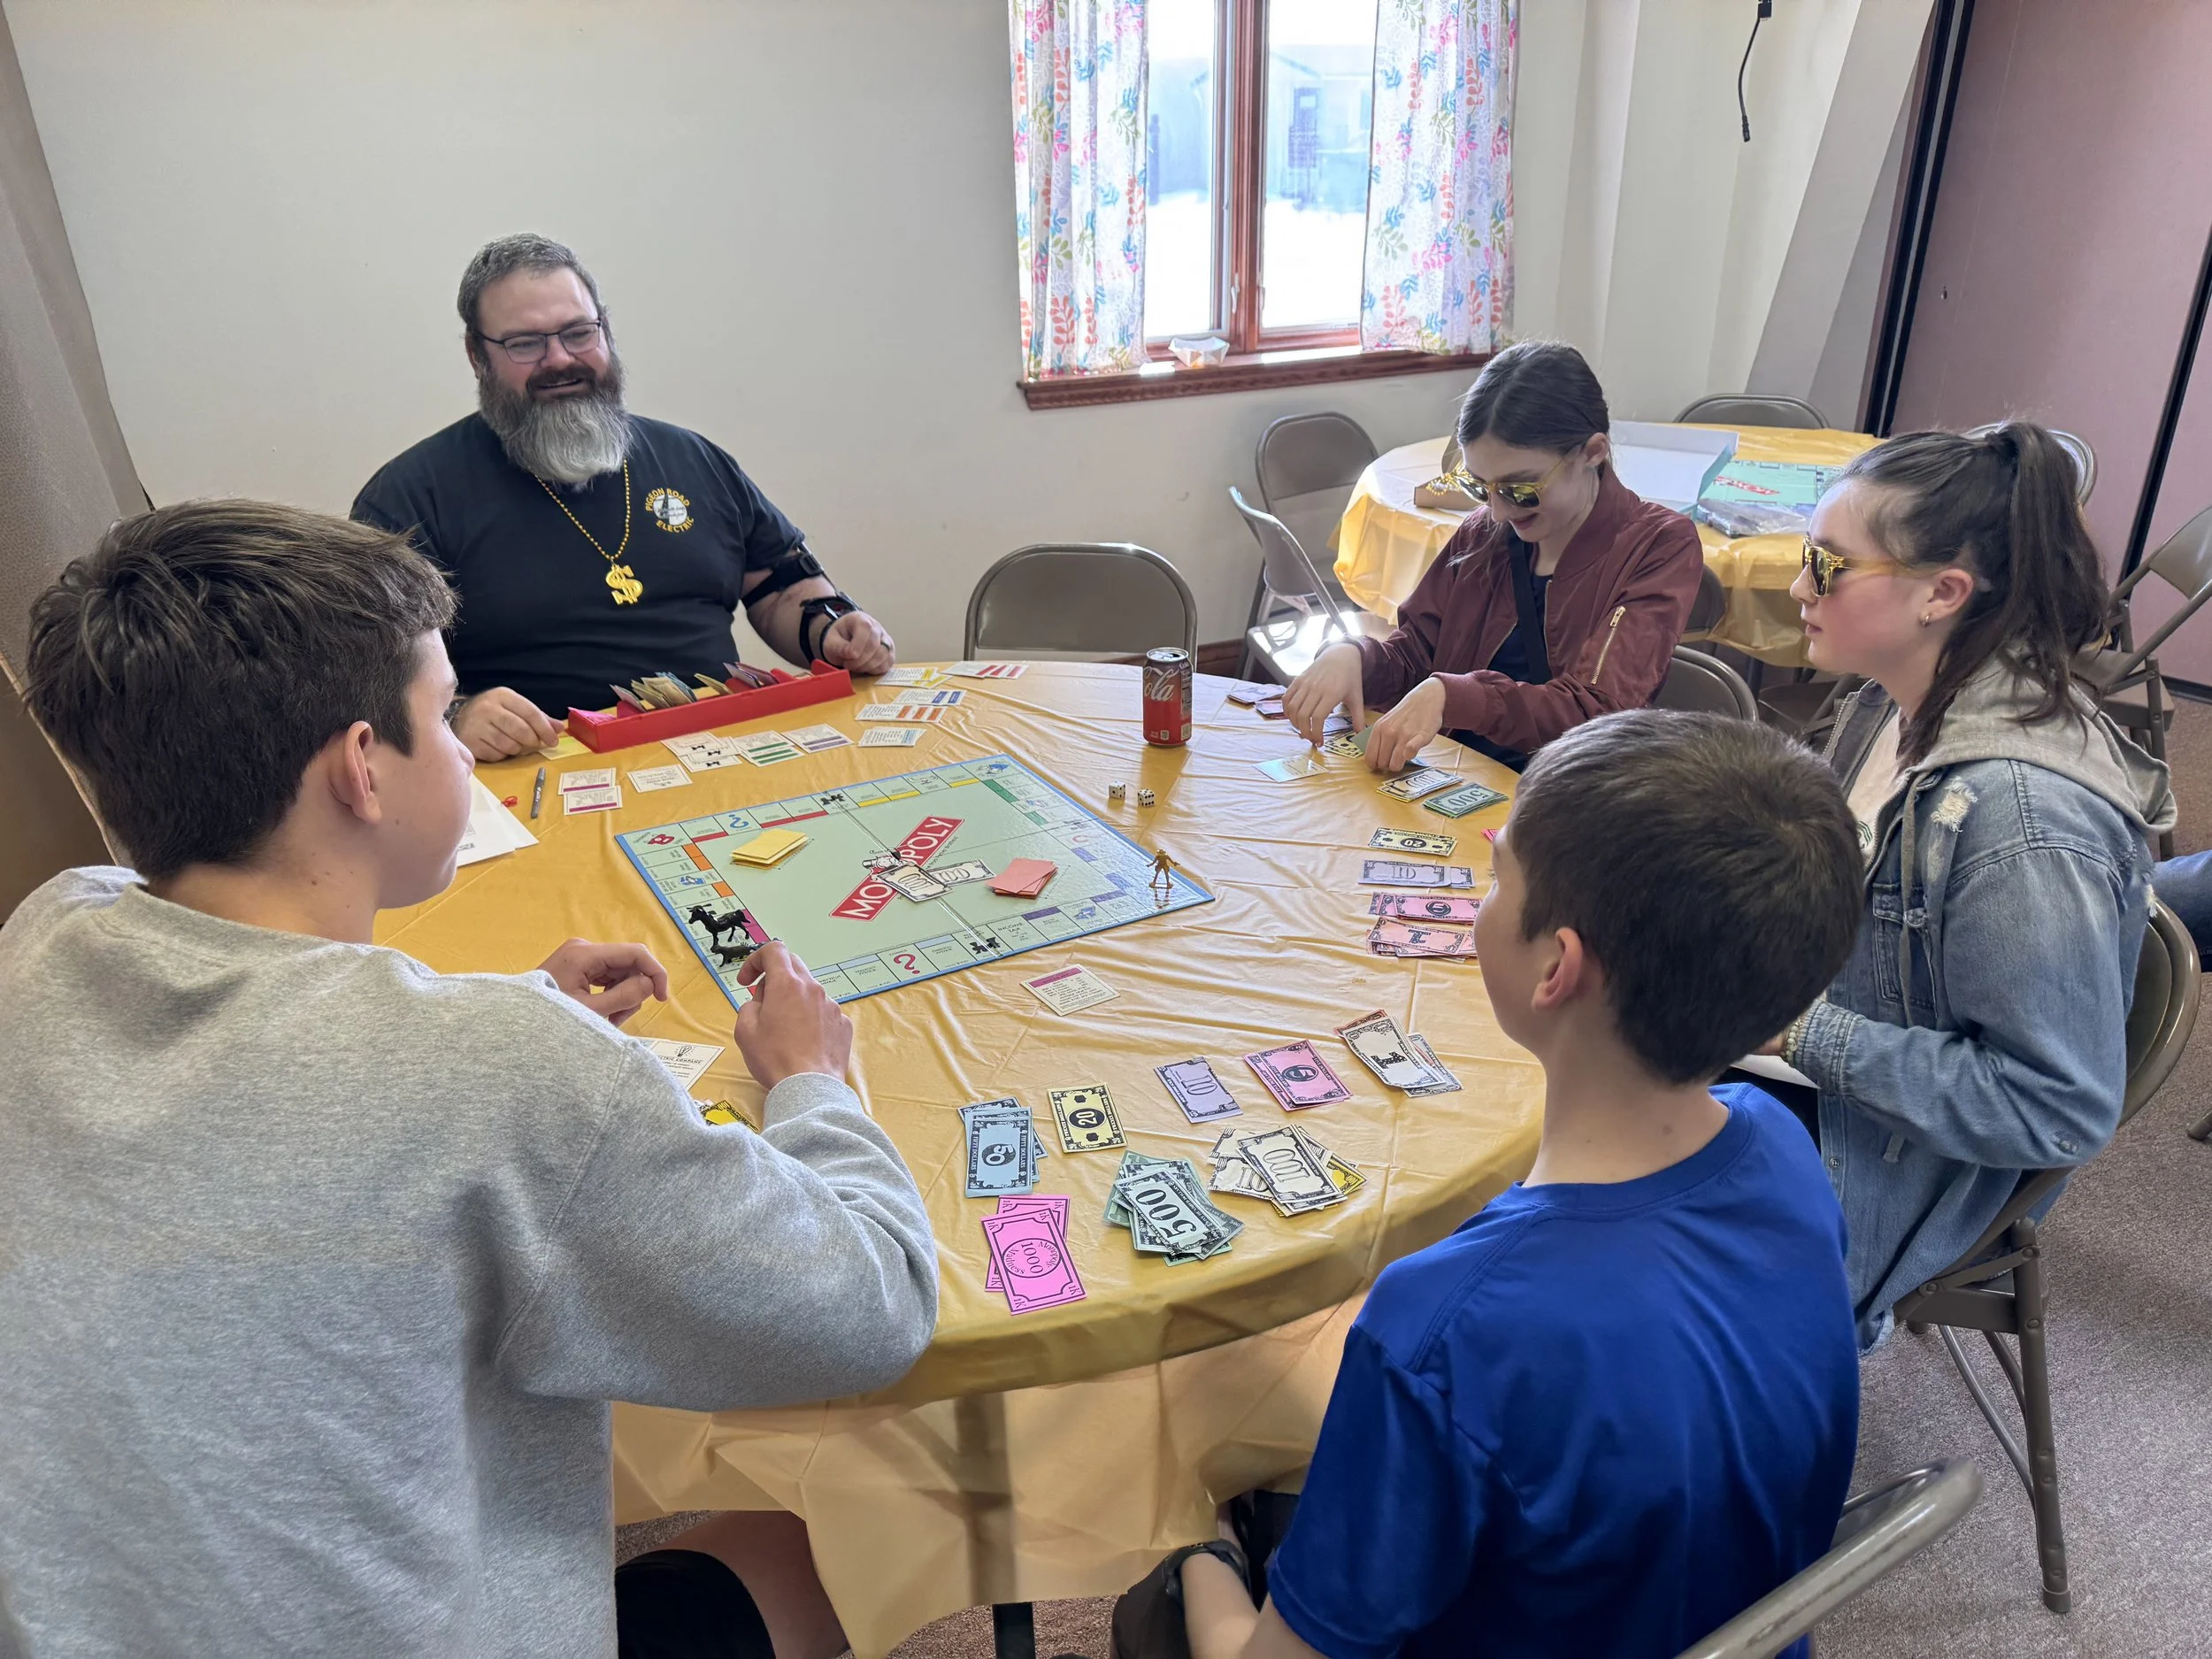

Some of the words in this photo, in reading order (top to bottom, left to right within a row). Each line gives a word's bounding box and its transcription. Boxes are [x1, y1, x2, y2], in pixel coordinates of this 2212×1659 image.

[645, 488, 664, 511] PIGEON
[667, 488, 690, 506] ROAD
[656, 516, 694, 533] ELECTRIC
[1448, 789, 1486, 807] 500
[840, 818, 954, 918] MOPOLY
[1392, 866, 1416, 879] 10
[1371, 1051, 1408, 1069] 1
[1286, 1067, 1313, 1080] 5
[1181, 1074, 1217, 1096] 10
[1078, 1110, 1098, 1126] 20
[986, 1144, 1014, 1165] 50
[1263, 1148, 1311, 1183] 100
[1002, 1200, 1013, 1209] 1K
[1055, 1201, 1064, 1210] 1K
[1040, 1211, 1051, 1221] 1K
[1135, 1188, 1197, 1239] 500
[987, 1221, 999, 1231] 1K
[1005, 1248, 1025, 1275] Madness
[1020, 1241, 1044, 1274] 1000
[1038, 1240, 1059, 1268] Monopoly
[991, 1277, 1001, 1286] 1K
[1068, 1285, 1081, 1295] 1K
[1013, 1298, 1026, 1308] 1K
